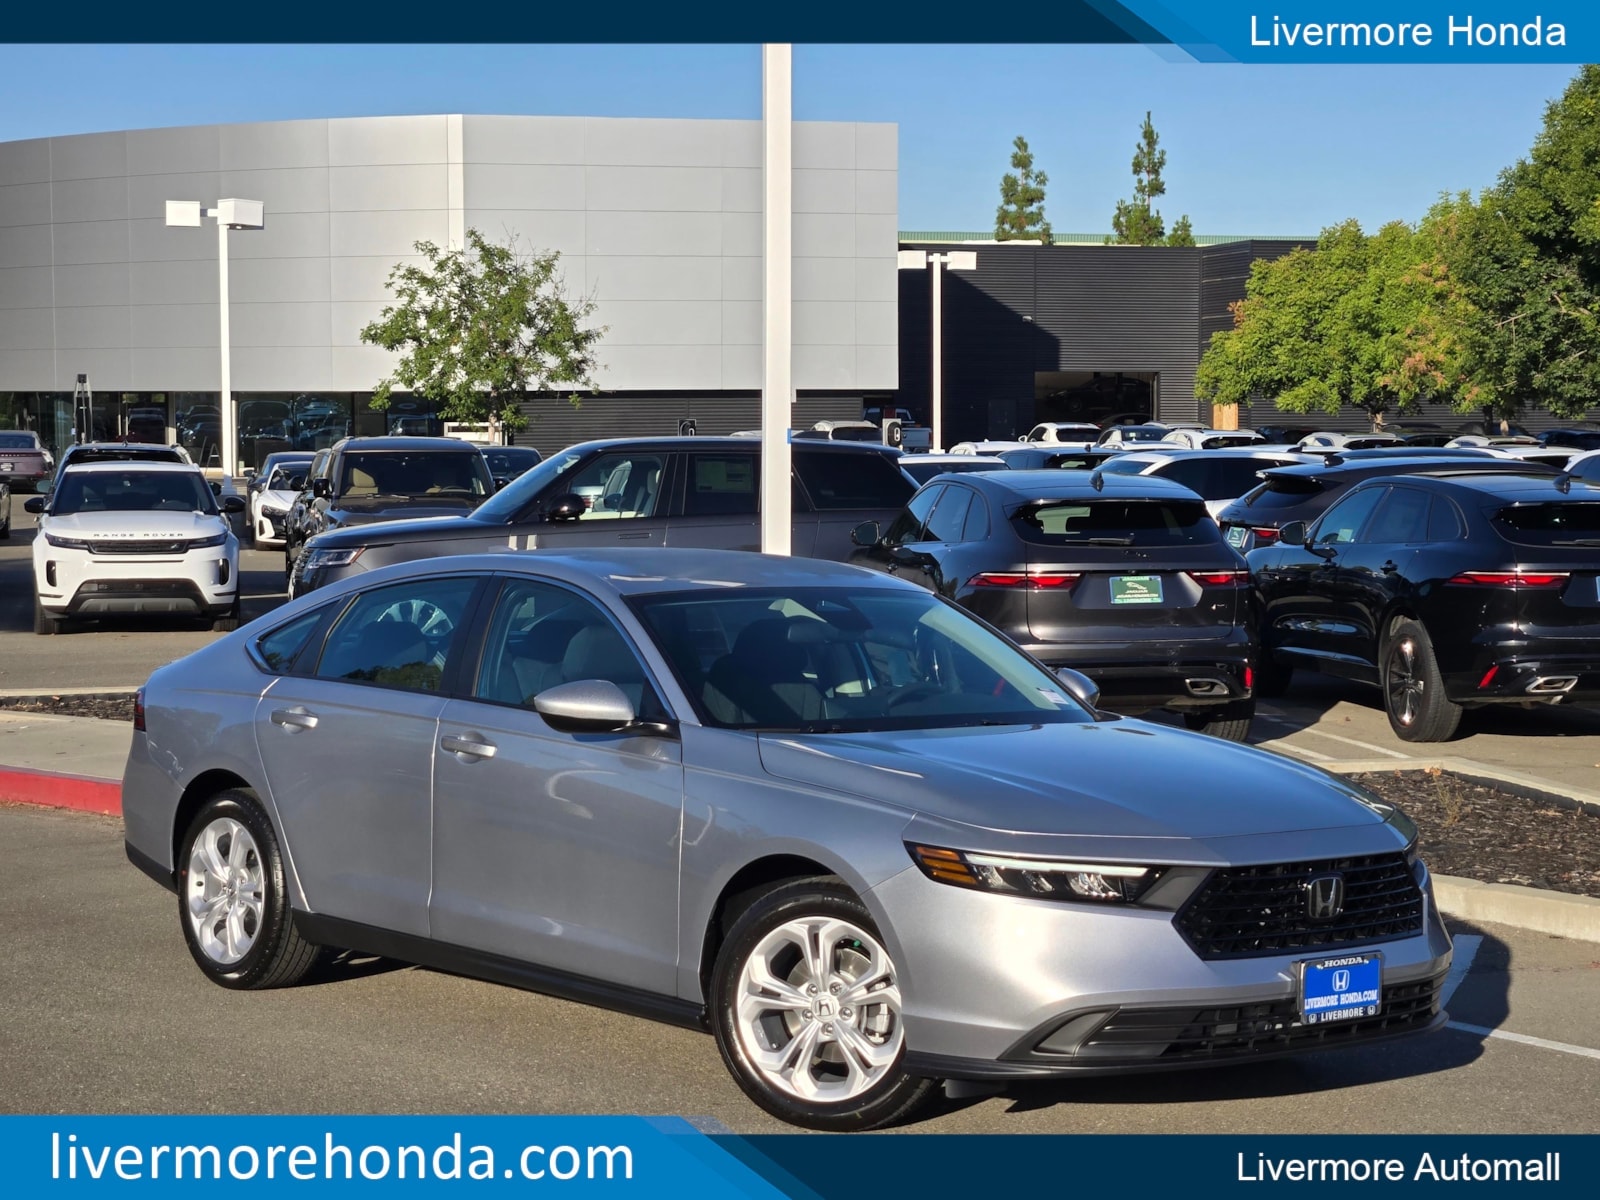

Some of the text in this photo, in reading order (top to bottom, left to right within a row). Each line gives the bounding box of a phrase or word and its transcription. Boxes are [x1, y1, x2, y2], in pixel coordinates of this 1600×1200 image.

[1324, 957, 1363, 968] HONDA
[1304, 990, 1378, 1010] LIVERMORE HONDA.COM
[1320, 1007, 1364, 1022] LIVERMORE
